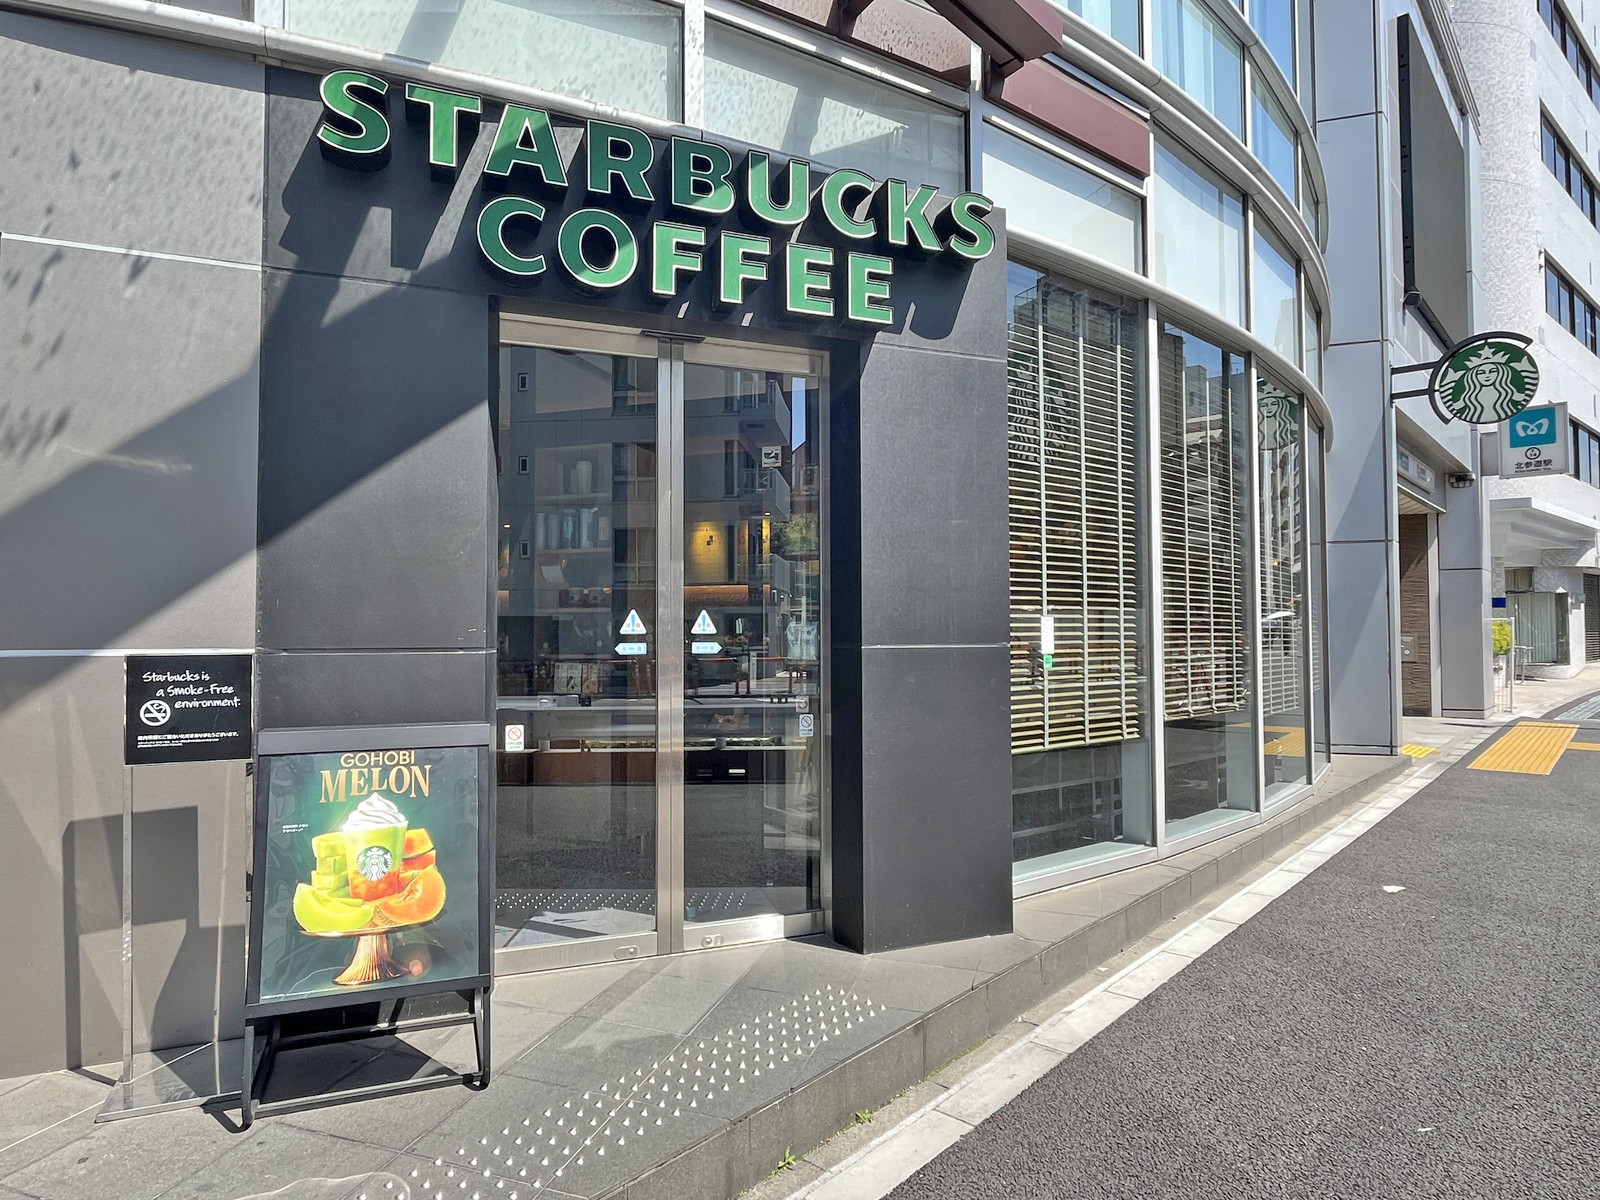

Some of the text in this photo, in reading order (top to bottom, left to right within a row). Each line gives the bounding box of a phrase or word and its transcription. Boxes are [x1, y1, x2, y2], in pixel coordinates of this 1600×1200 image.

[317, 69, 996, 260] STARBUCKS
[476, 196, 894, 325] COFFEE
[1515, 459, 1552, 469] 北参道駅
[142, 669, 211, 683] Starbucks is
[155, 688, 165, 697] a
[340, 750, 415, 768] GOHOBI
[318, 764, 432, 804] MELON
